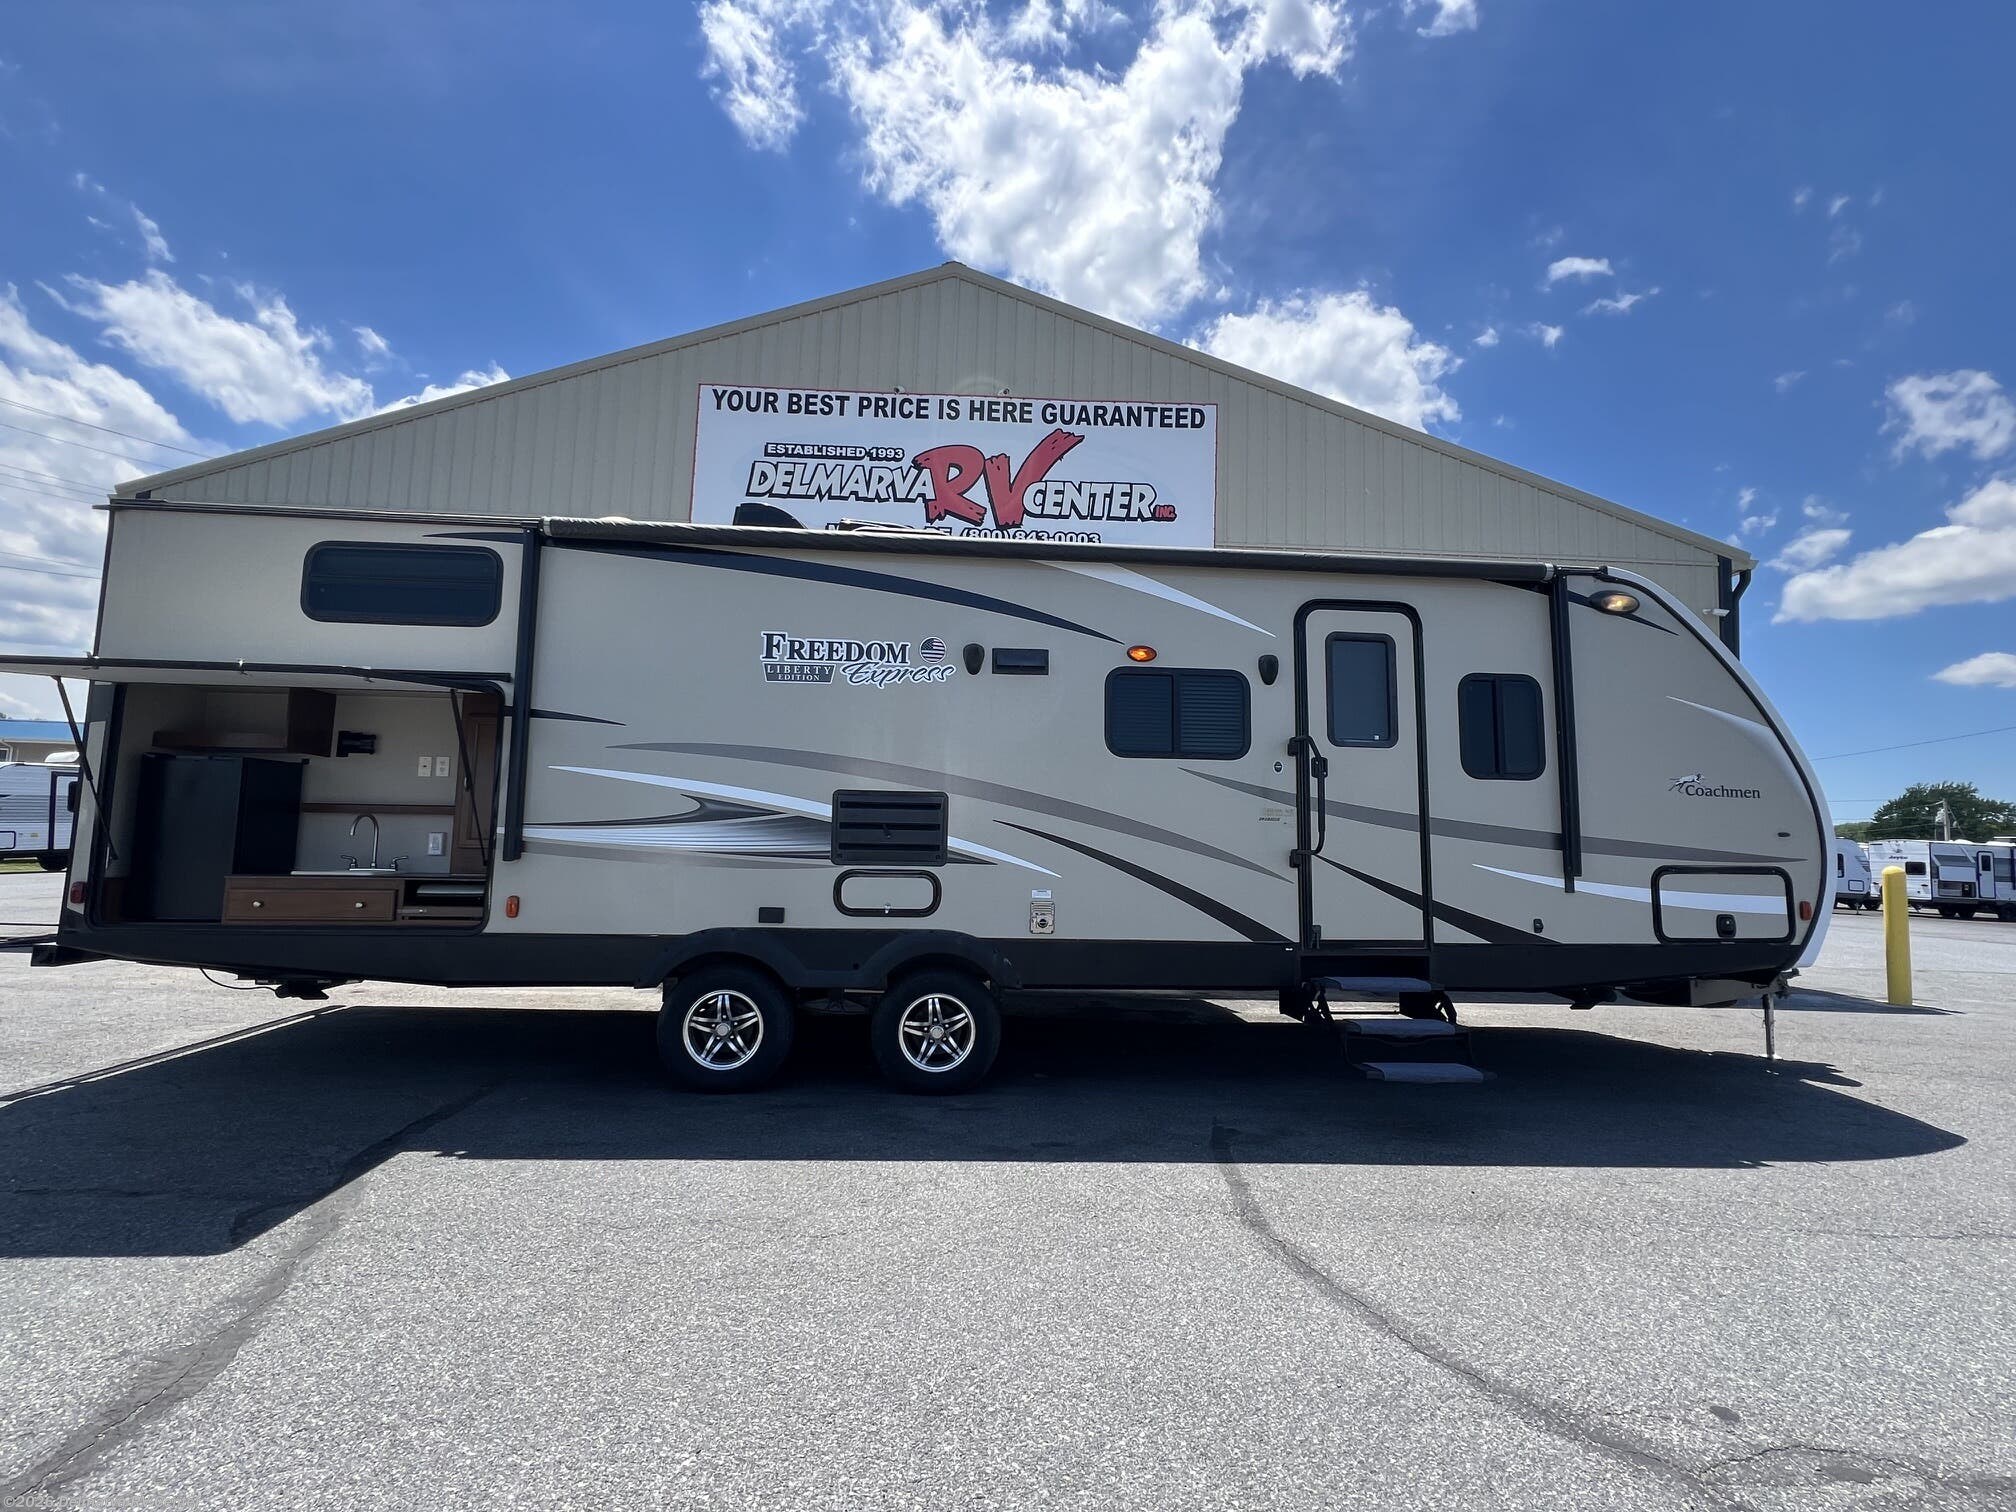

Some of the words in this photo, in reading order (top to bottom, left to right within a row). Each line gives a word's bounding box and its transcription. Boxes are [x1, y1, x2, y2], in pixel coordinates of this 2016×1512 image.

[712, 388, 779, 413] YOUR
[787, 392, 851, 416] BEST
[858, 396, 930, 420] PRICE
[938, 399, 960, 421] IS
[968, 400, 1033, 424] HERE
[1041, 403, 1206, 429] GUARANTEED
[765, 443, 867, 459] ESTABLISHED
[869, 447, 905, 461] 1993
[747, 461, 936, 502] DELMARVA
[912, 429, 1085, 529] RV
[1022, 481, 1157, 521] CENTER
[761, 632, 911, 665] FREEDOM
[767, 666, 832, 675] LIBERTY
[777, 674, 821, 682] EDITION
[840, 661, 955, 689] Express
[1685, 784, 1761, 799] Coachmen
